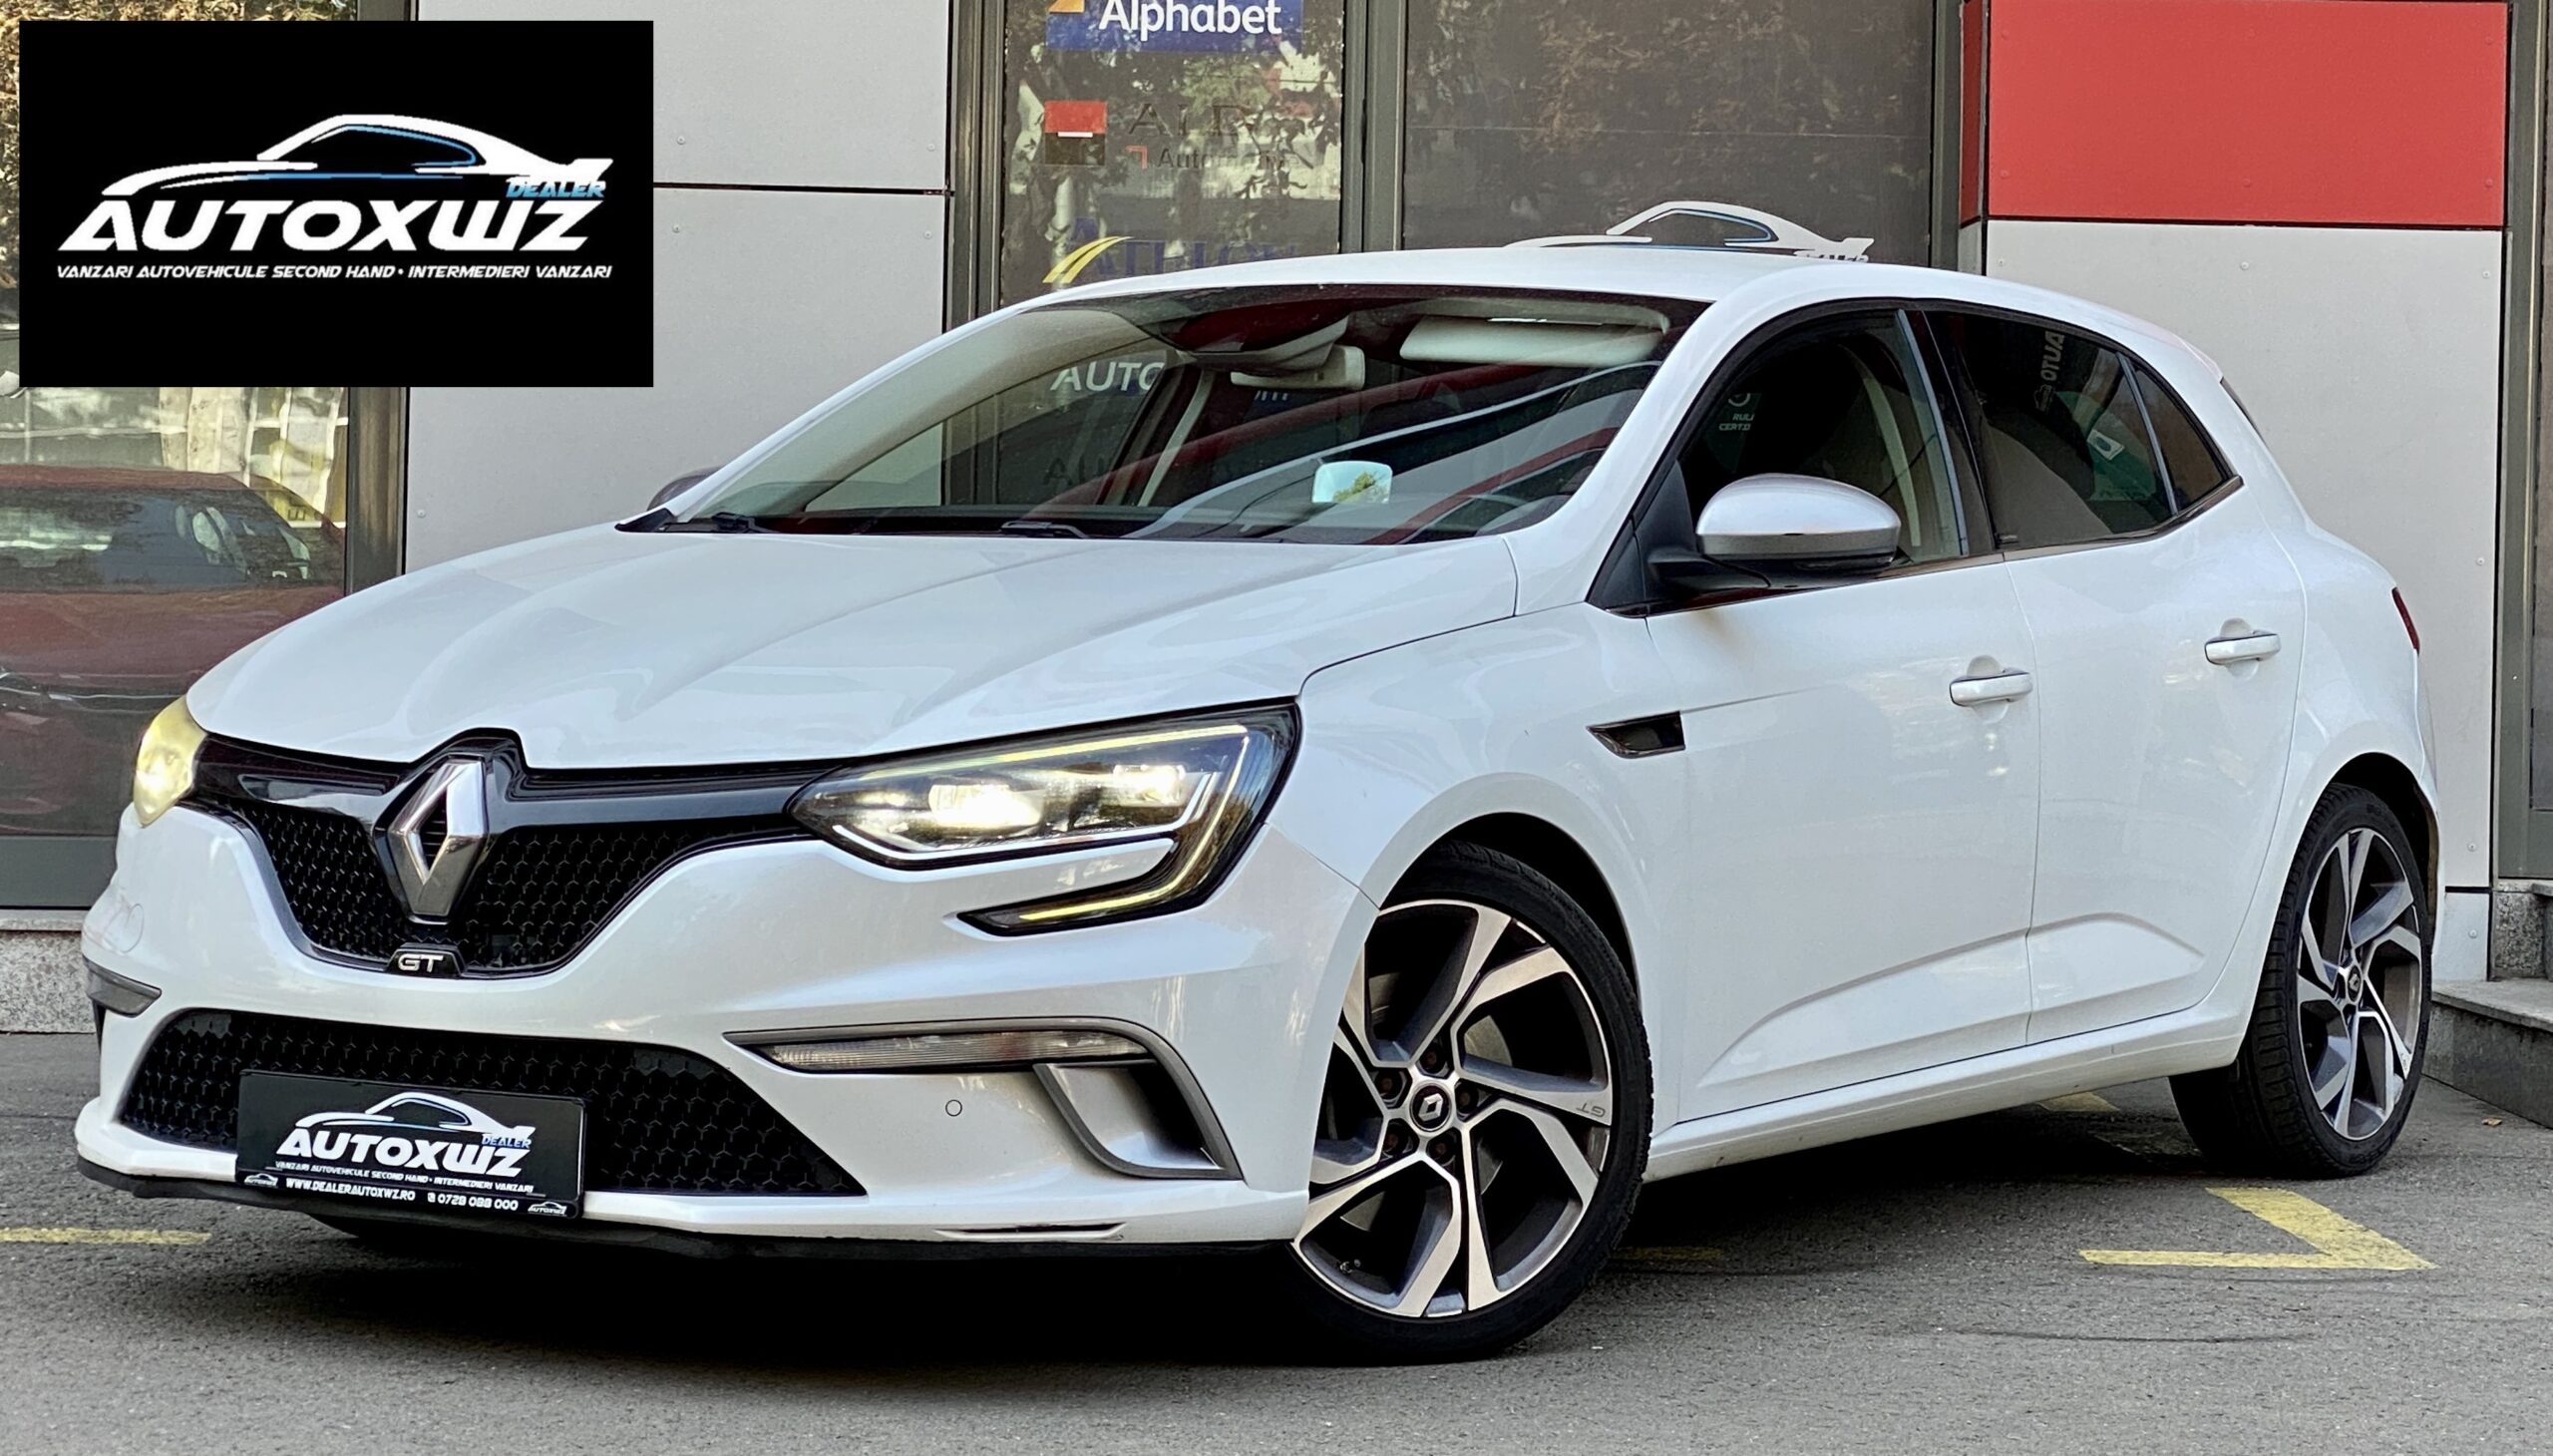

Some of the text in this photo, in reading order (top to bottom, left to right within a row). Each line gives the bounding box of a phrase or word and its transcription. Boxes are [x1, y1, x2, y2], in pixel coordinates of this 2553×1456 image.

[1098, 0, 1282, 41] Alphabet
[398, 952, 444, 973] GT
[1576, 1102, 1606, 1118] GT
[276, 1128, 531, 1178] AUTOXWZ
[482, 1134, 532, 1149] DEALER
[275, 1161, 534, 1194] VANZARI AUTOVEHICULE SECOND HAND INTERMEDIERI VANZARI
[285, 1178, 416, 1201] WWW.DEALERAUTOXWZ.RO
